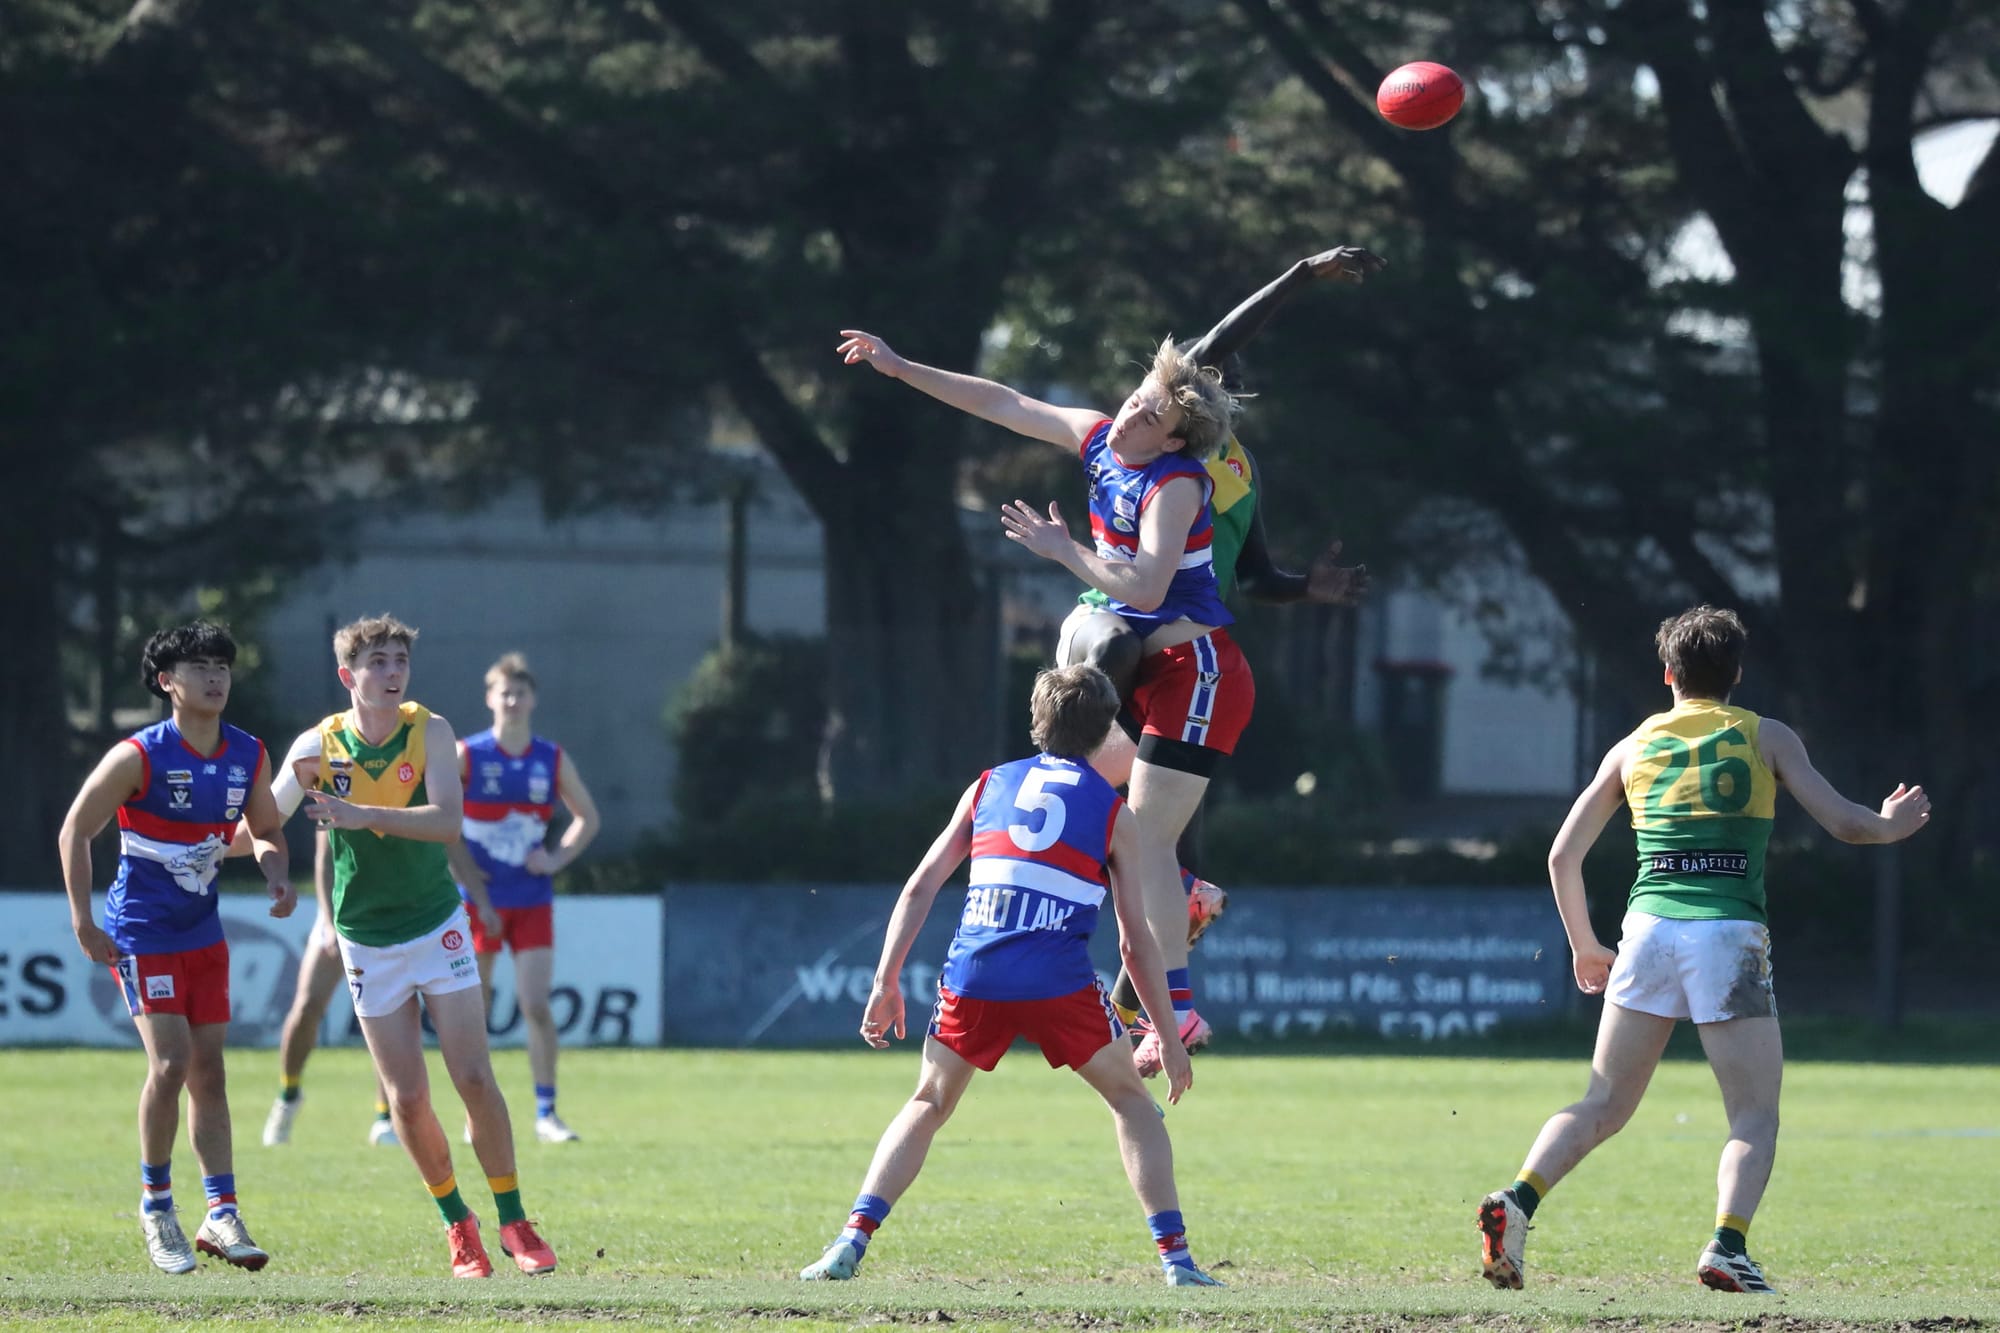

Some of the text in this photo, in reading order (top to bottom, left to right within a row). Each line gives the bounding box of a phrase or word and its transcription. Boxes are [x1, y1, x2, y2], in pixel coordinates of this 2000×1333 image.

[1643, 727, 1752, 824] 26
[1008, 767, 1081, 852] 5
[1681, 858, 1747, 872] GARFIELD
[964, 888, 1016, 929] SALT
